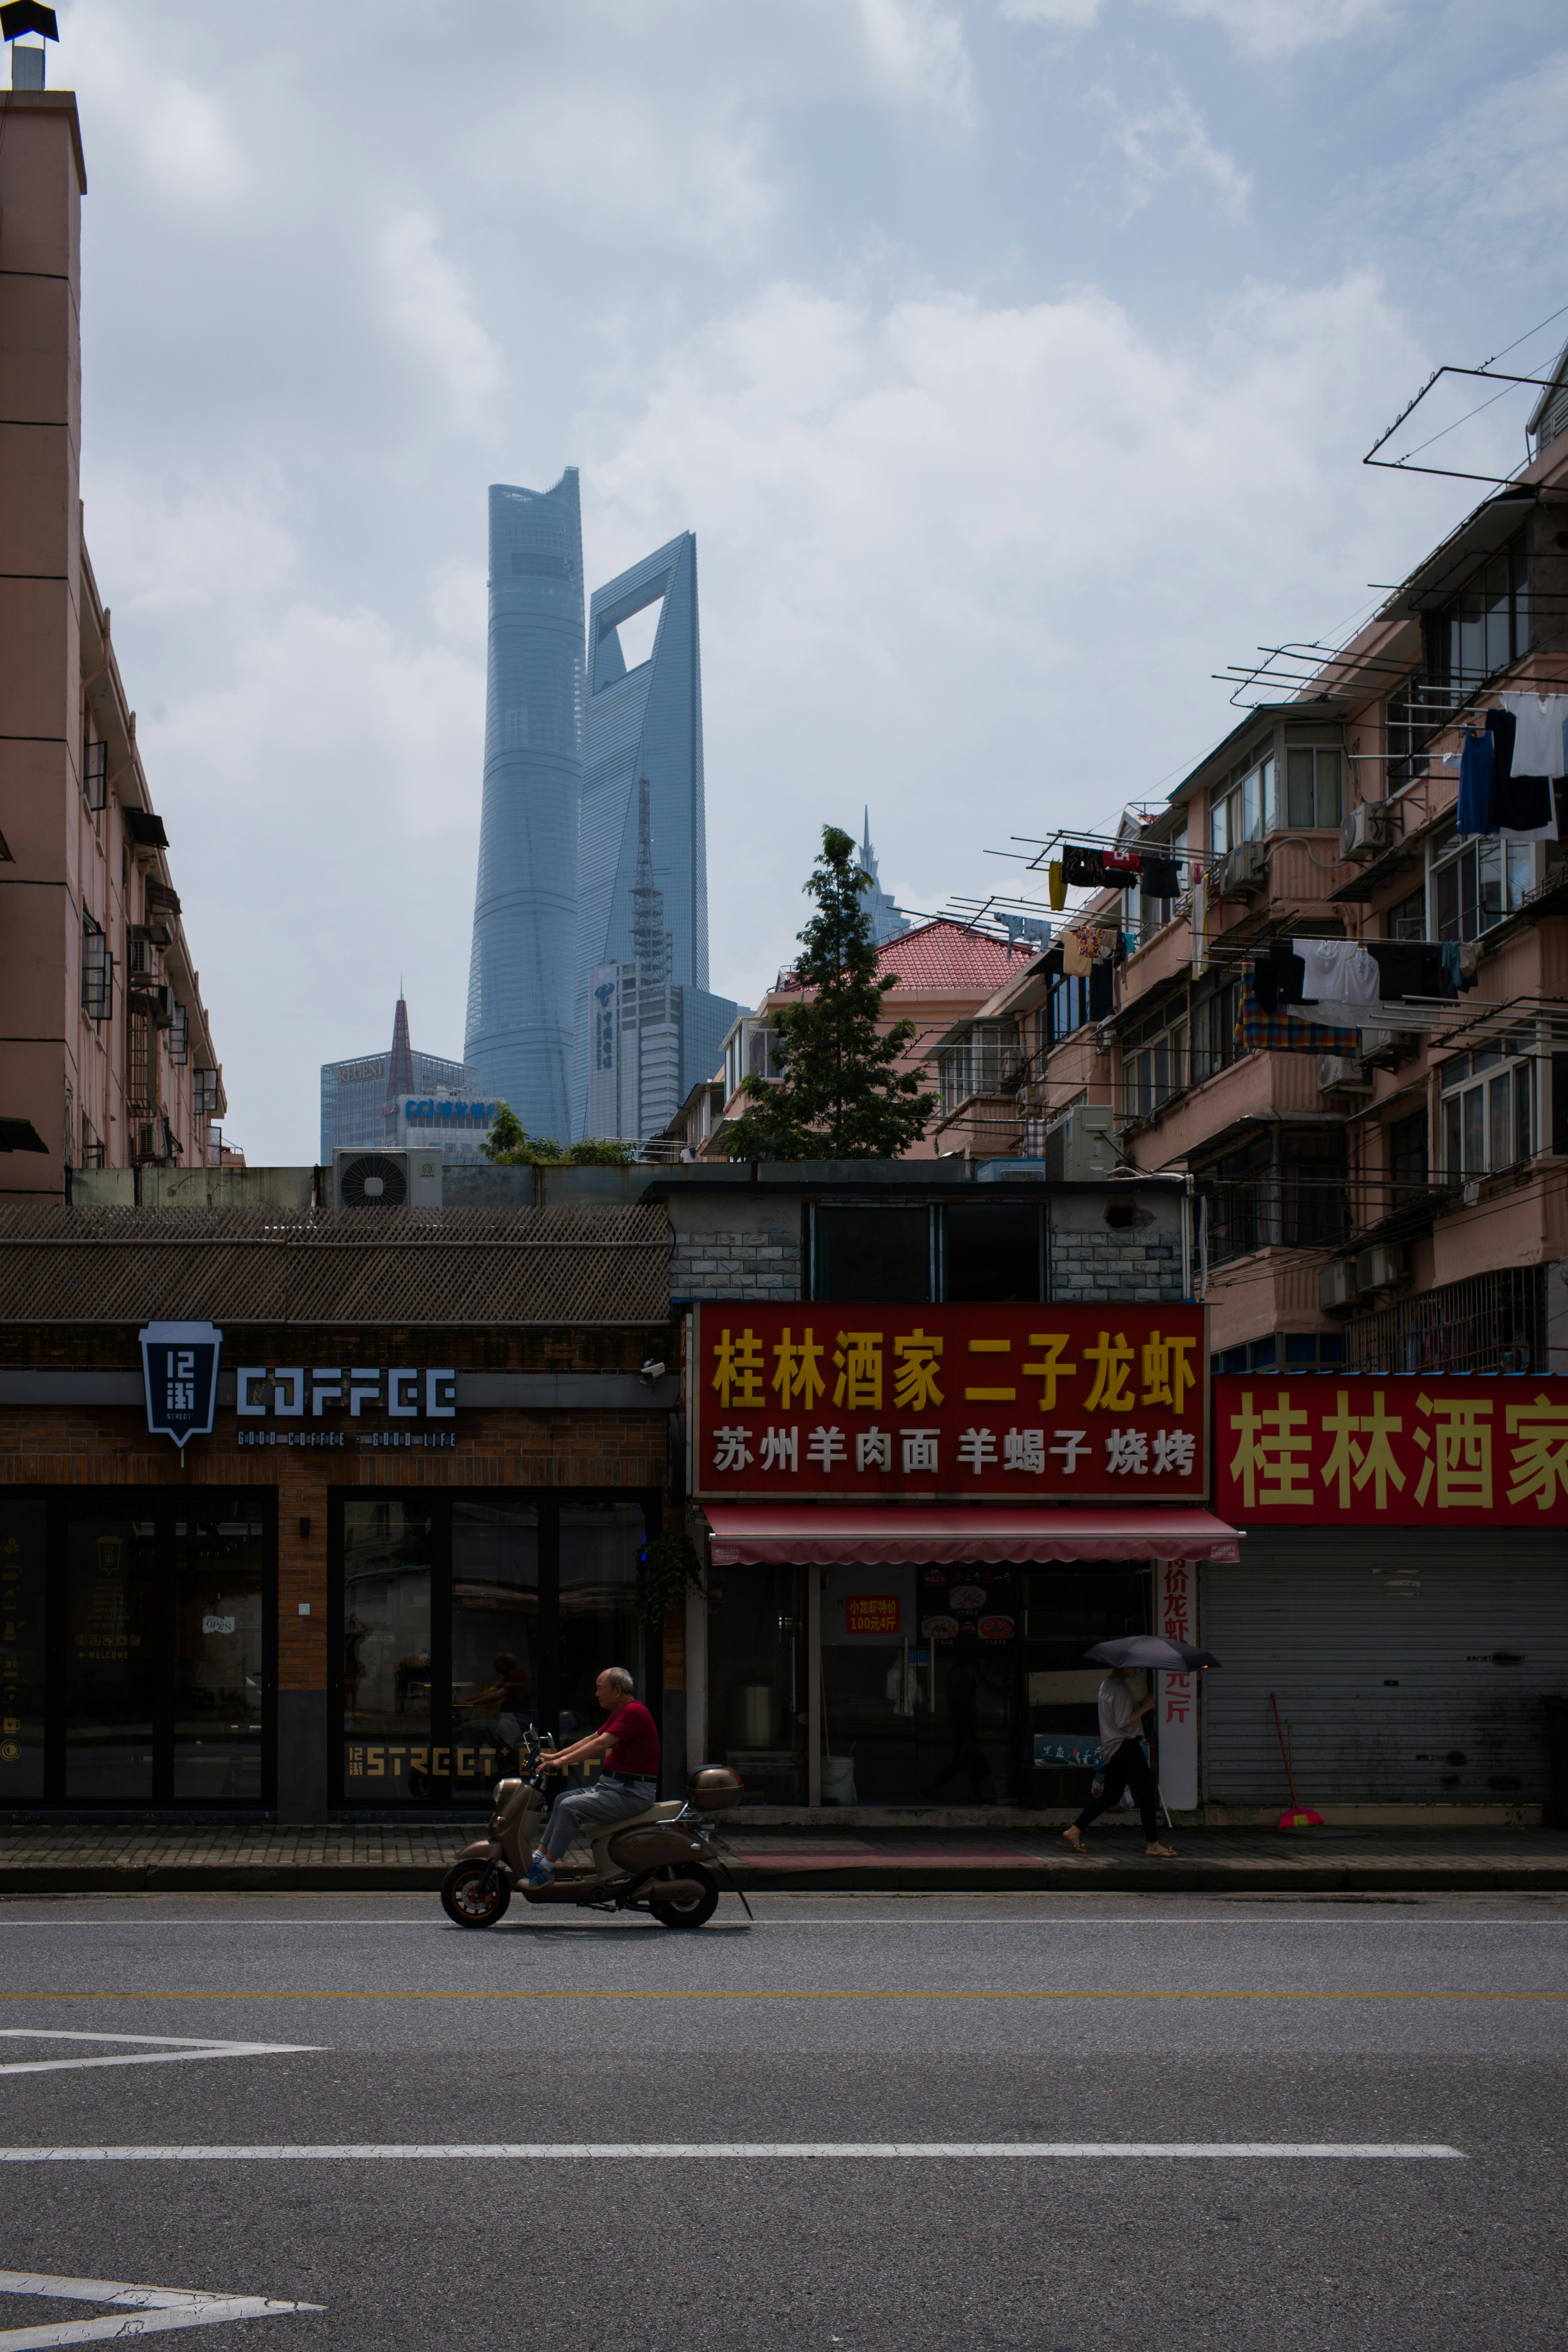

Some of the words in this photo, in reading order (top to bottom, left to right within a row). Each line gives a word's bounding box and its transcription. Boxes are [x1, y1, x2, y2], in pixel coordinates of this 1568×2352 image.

[603, 1010, 612, 1068] 中国电信
[338, 1061, 384, 1083] REGENT
[436, 1101, 499, 1119] 浦发银行
[167, 1351, 194, 1378] 12
[712, 1328, 945, 1412] 桂林酒家
[964, 1331, 1196, 1414] 二子龙虾
[237, 1367, 456, 1417] COFFEE
[238, 1431, 276, 1445] GOOD
[288, 1431, 345, 1446] COFFEE
[372, 1432, 411, 1446] GOOD
[424, 1432, 456, 1446] LIFE
[1229, 1390, 1568, 1511] 桂林酒家
[712, 1426, 941, 1473] 苏州羊肉面
[956, 1427, 1092, 1475] 羊蝎子
[1105, 1429, 1196, 1476] 烧烤
[850, 1600, 897, 1614] 小龙虾特价
[207, 1620, 231, 1631] OPEN
[851, 1616, 896, 1630] 100元4斤
[349, 1747, 362, 1760] 12
[367, 1747, 496, 1776] STREET
